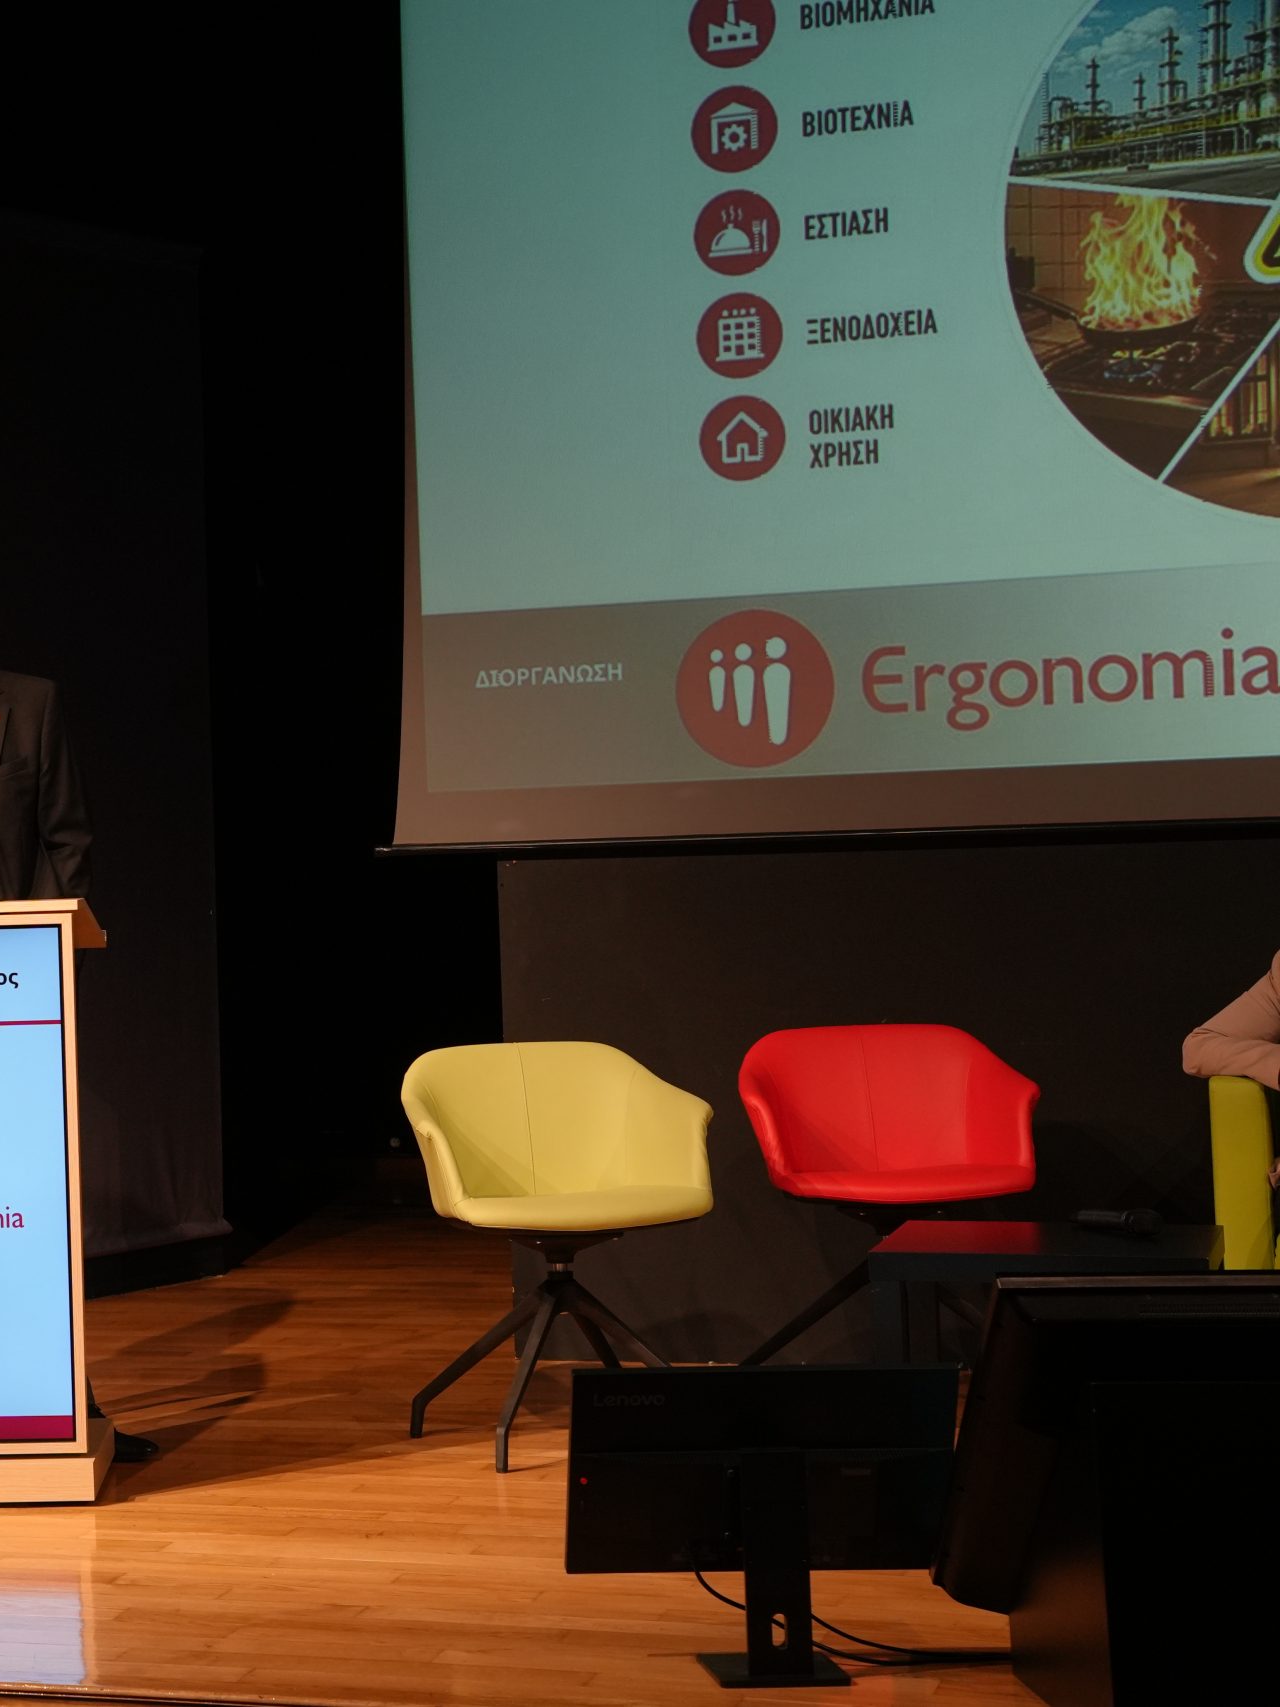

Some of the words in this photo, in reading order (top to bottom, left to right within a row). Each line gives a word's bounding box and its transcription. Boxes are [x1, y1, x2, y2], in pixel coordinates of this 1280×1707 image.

[802, 99, 914, 137] ΒΙΟΤΕΧΝΙΑ
[804, 206, 889, 241] ΕΣΤΙΑΣΗ
[806, 308, 938, 345] ΞΕΝΟΔΟΧΕΙΑ
[808, 403, 894, 436] ΟΙΚΙΑΚΗ
[809, 438, 880, 469] ΧΡΗΣΗ
[475, 662, 623, 689] ΔΙΟΡΓΑΝΩΣΗ
[861, 627, 1280, 731] Ergonomia
[592, 1391, 666, 1409] Lenovo
